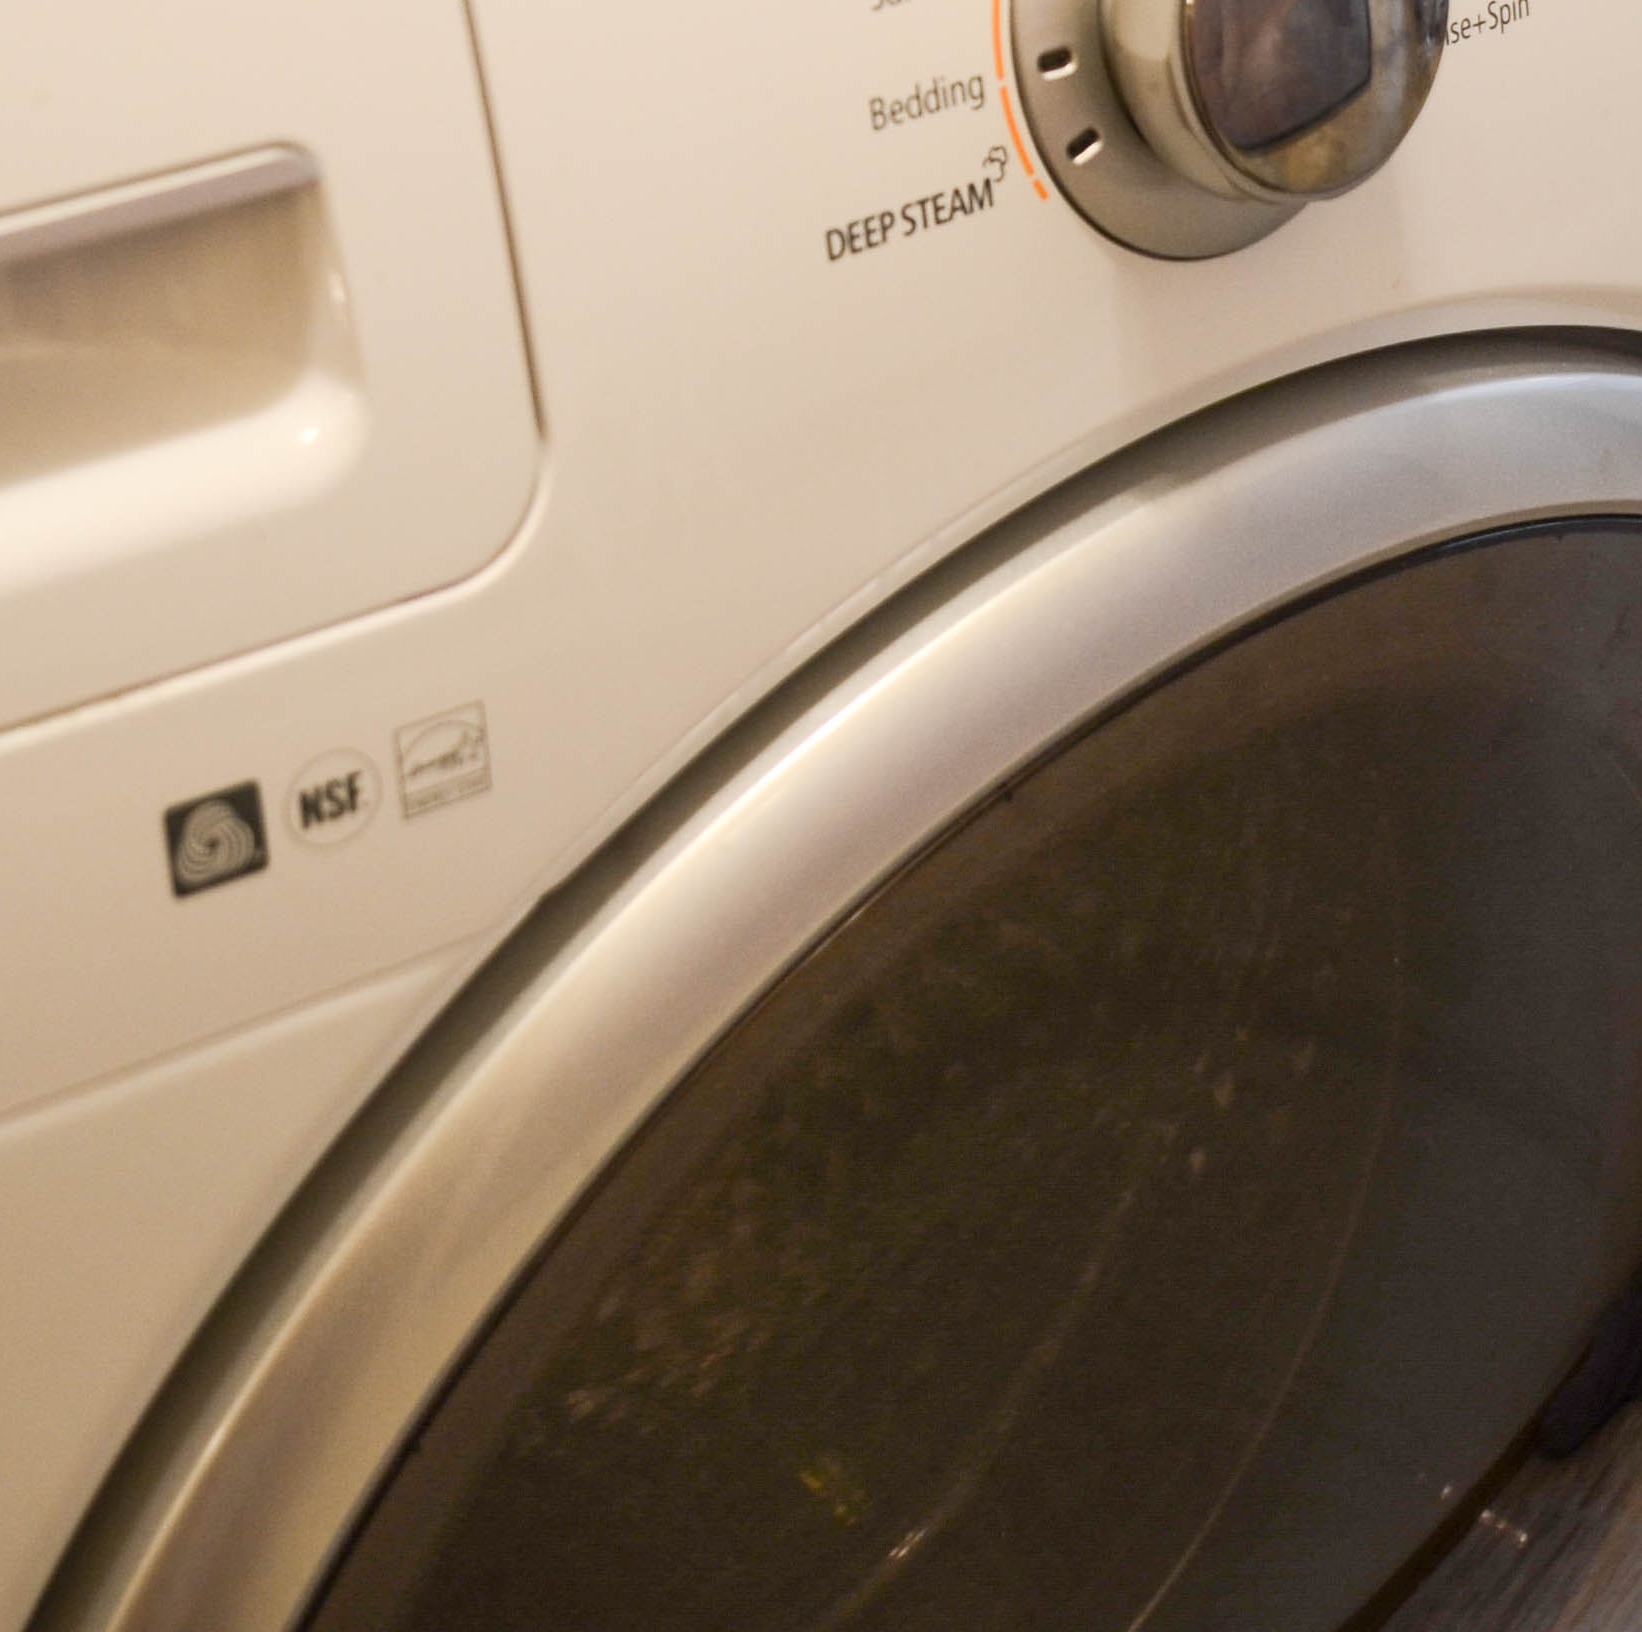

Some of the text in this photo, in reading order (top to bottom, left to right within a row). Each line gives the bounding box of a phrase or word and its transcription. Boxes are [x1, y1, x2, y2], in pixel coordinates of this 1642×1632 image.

[868, 68, 986, 133] Bedding
[824, 176, 996, 264] DEEP STEAM
[298, 769, 365, 831] NSF
